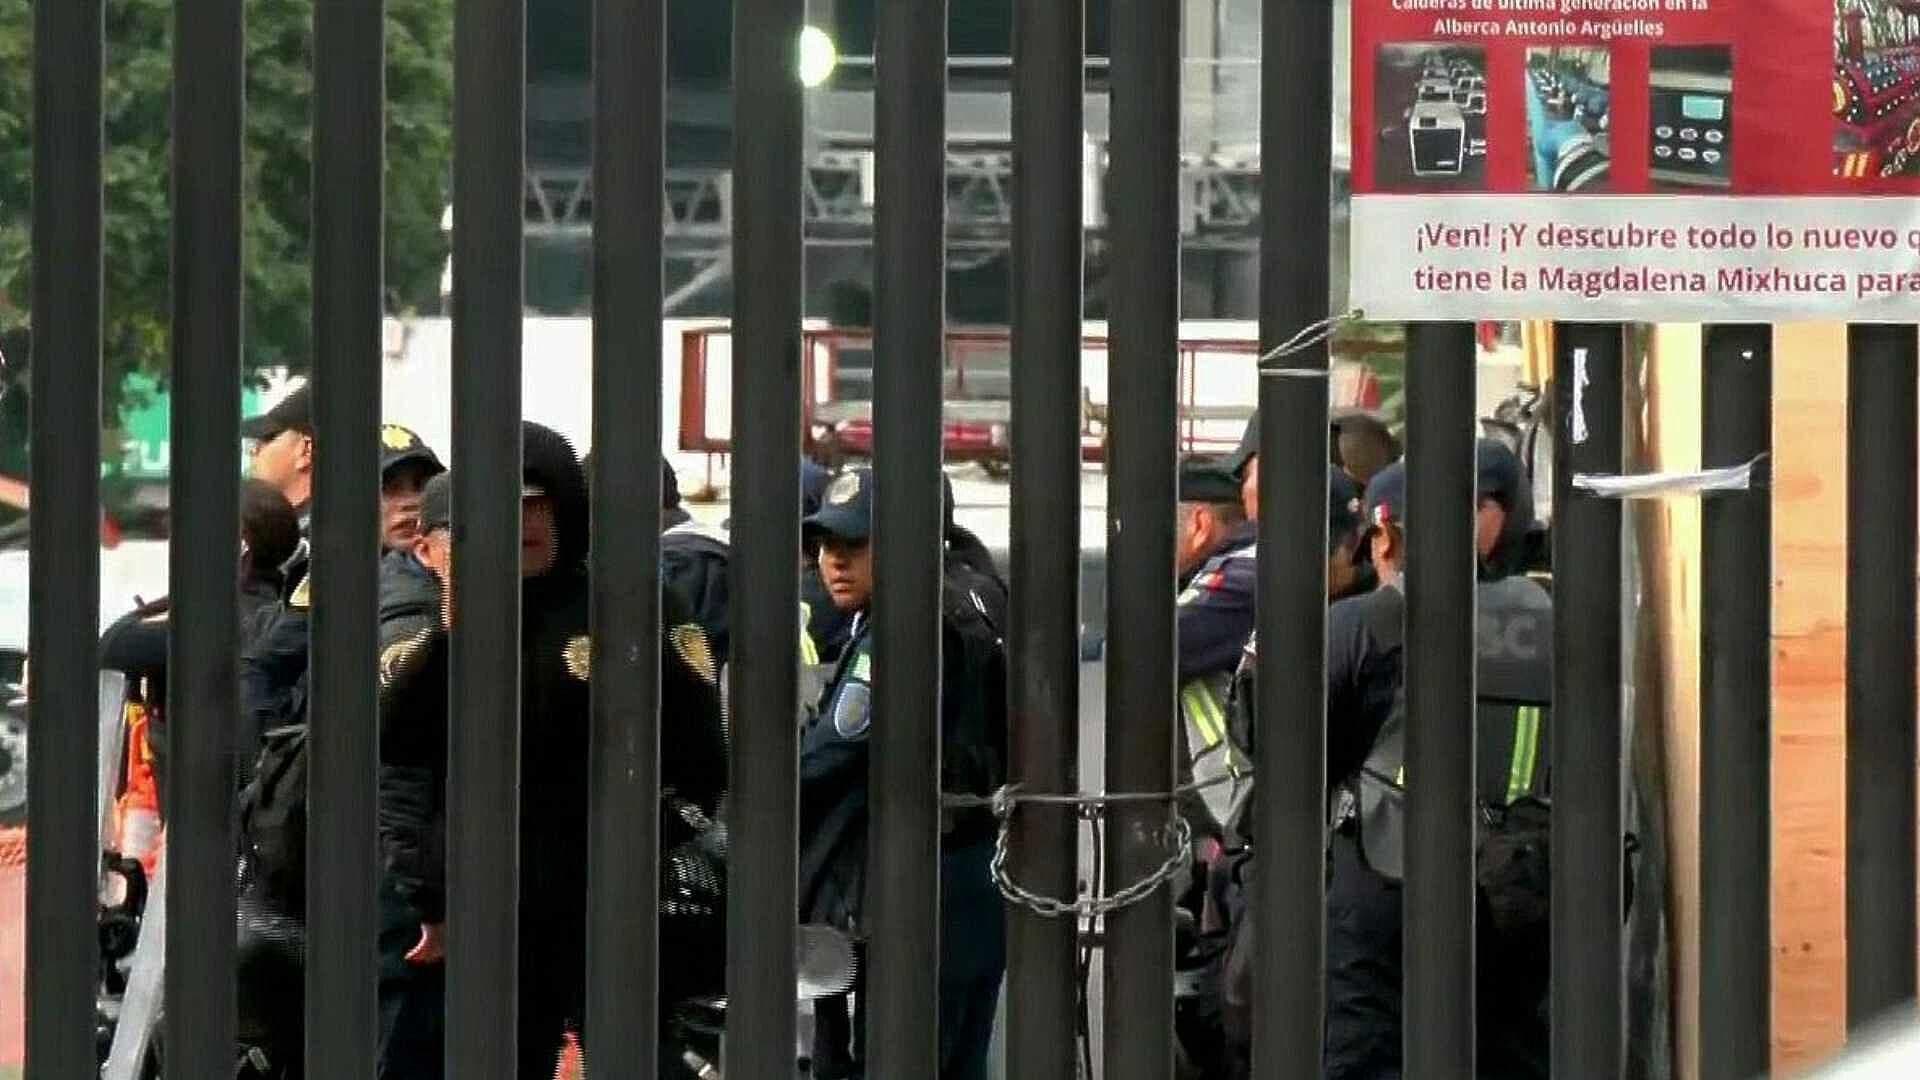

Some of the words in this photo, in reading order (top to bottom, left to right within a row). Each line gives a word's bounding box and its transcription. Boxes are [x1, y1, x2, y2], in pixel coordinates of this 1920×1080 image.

[1433, 18, 1500, 35] Alberca
[1505, 19, 1577, 36] Antonio
[1580, 19, 1665, 39] Argüelles
[1417, 223, 1490, 251] ¡Ven!
[1501, 223, 1527, 252] ¡Y
[1537, 223, 1677, 249] descubre
[1688, 223, 1757, 249] todo
[1767, 223, 1793, 249] lo
[1804, 228, 1898, 249] nuevo
[1415, 265, 1492, 290] tiene
[1502, 265, 1527, 290] la
[1538, 266, 1706, 298] Magdalena
[1718, 267, 1847, 293] Mixhuca
